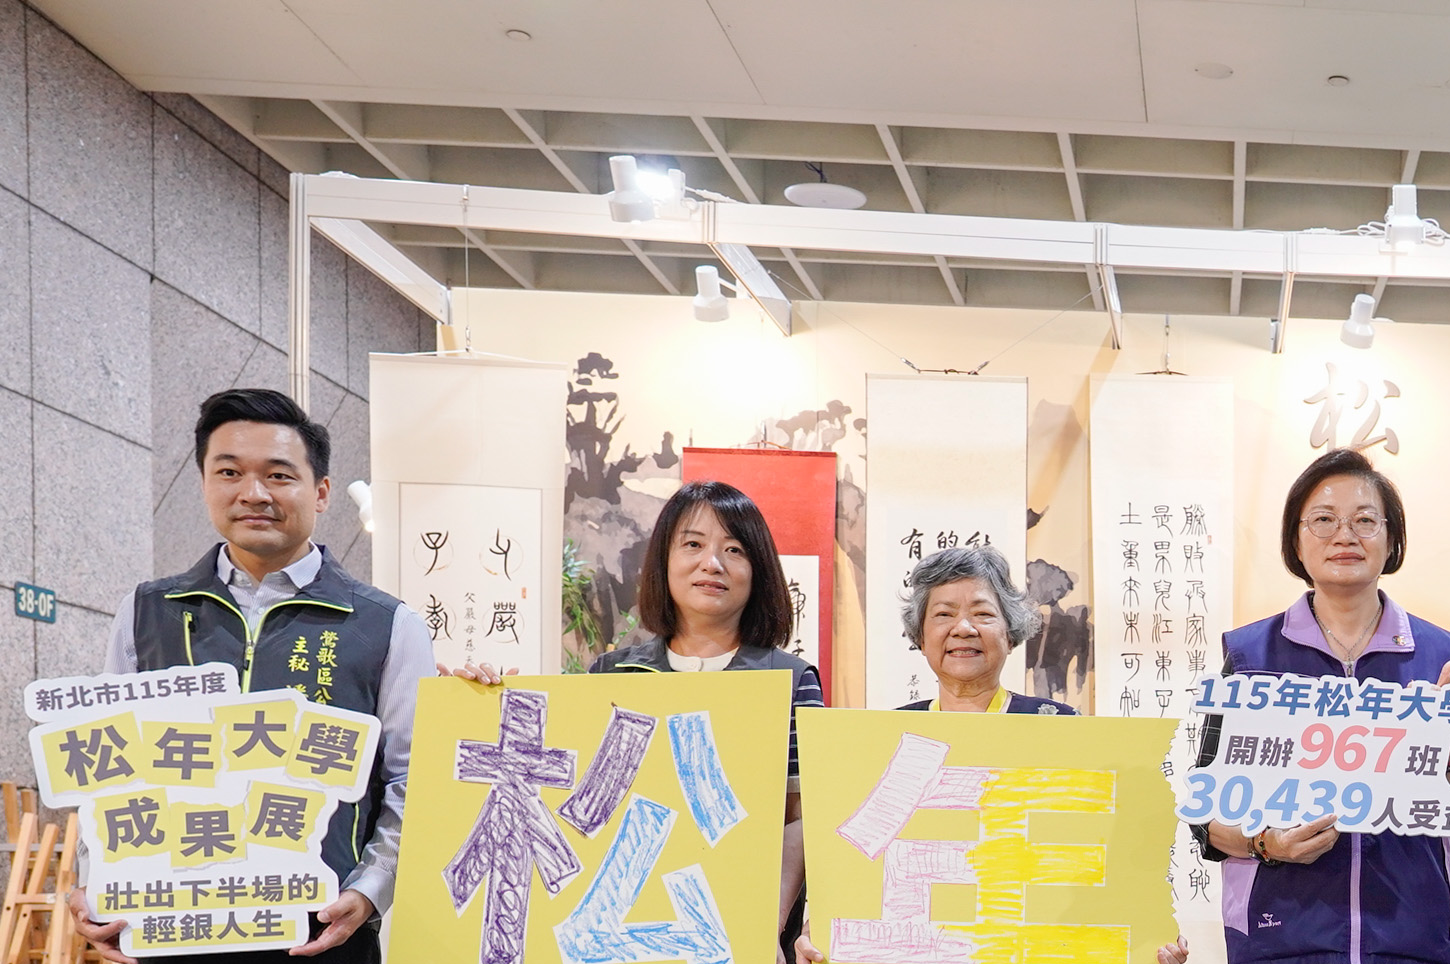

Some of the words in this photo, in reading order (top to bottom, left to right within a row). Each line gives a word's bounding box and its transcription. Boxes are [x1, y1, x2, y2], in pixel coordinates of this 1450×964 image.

[1303, 362, 1400, 455] 松
[35, 671, 228, 712] 新北市115年度
[59, 710, 360, 787] 松年大學
[104, 792, 308, 858] 成果展
[104, 873, 319, 911] 壯出下半場的
[142, 909, 285, 944] 輕銀人生
